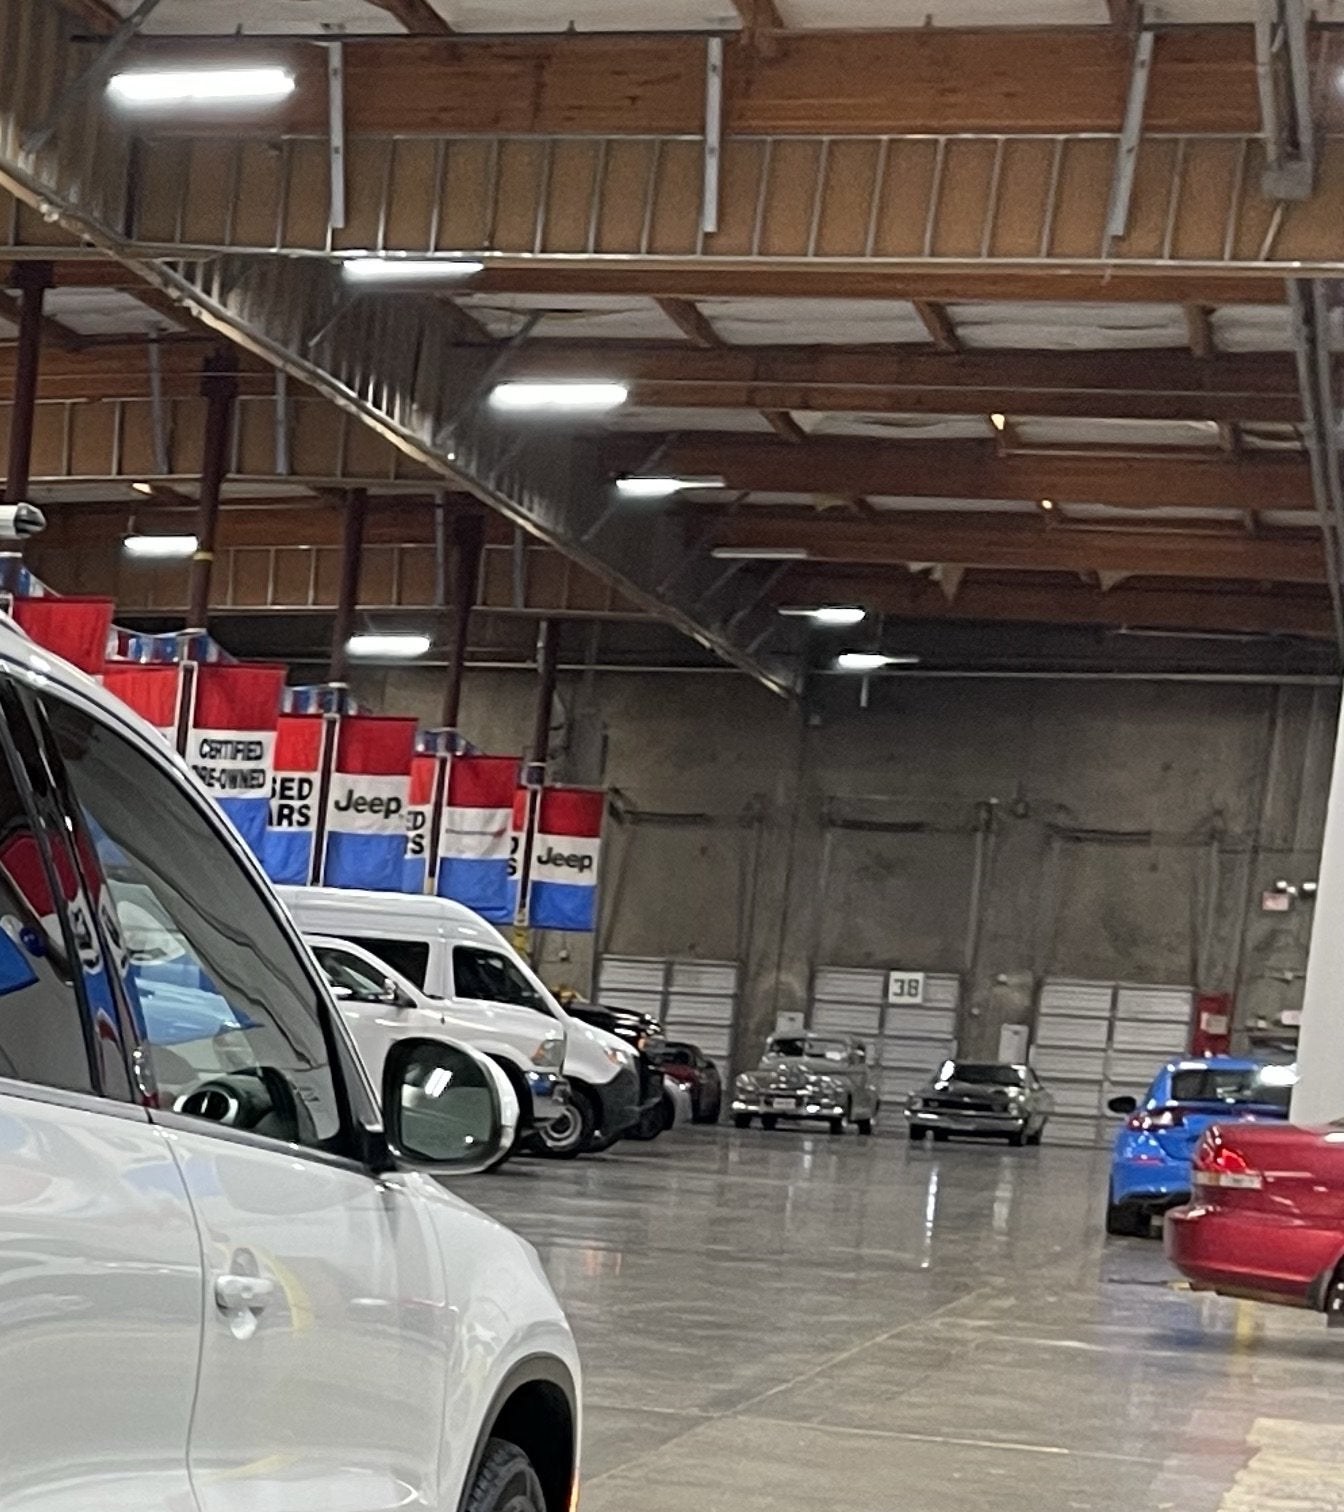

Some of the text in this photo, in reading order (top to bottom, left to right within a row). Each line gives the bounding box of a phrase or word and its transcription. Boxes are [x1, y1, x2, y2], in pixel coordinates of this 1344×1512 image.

[199, 738, 264, 760] CERTIFIED
[272, 777, 313, 800] ED
[268, 803, 311, 827] RS
[334, 789, 403, 819] Jeep
[537, 847, 593, 871] Jeep
[893, 978, 920, 998] 38
